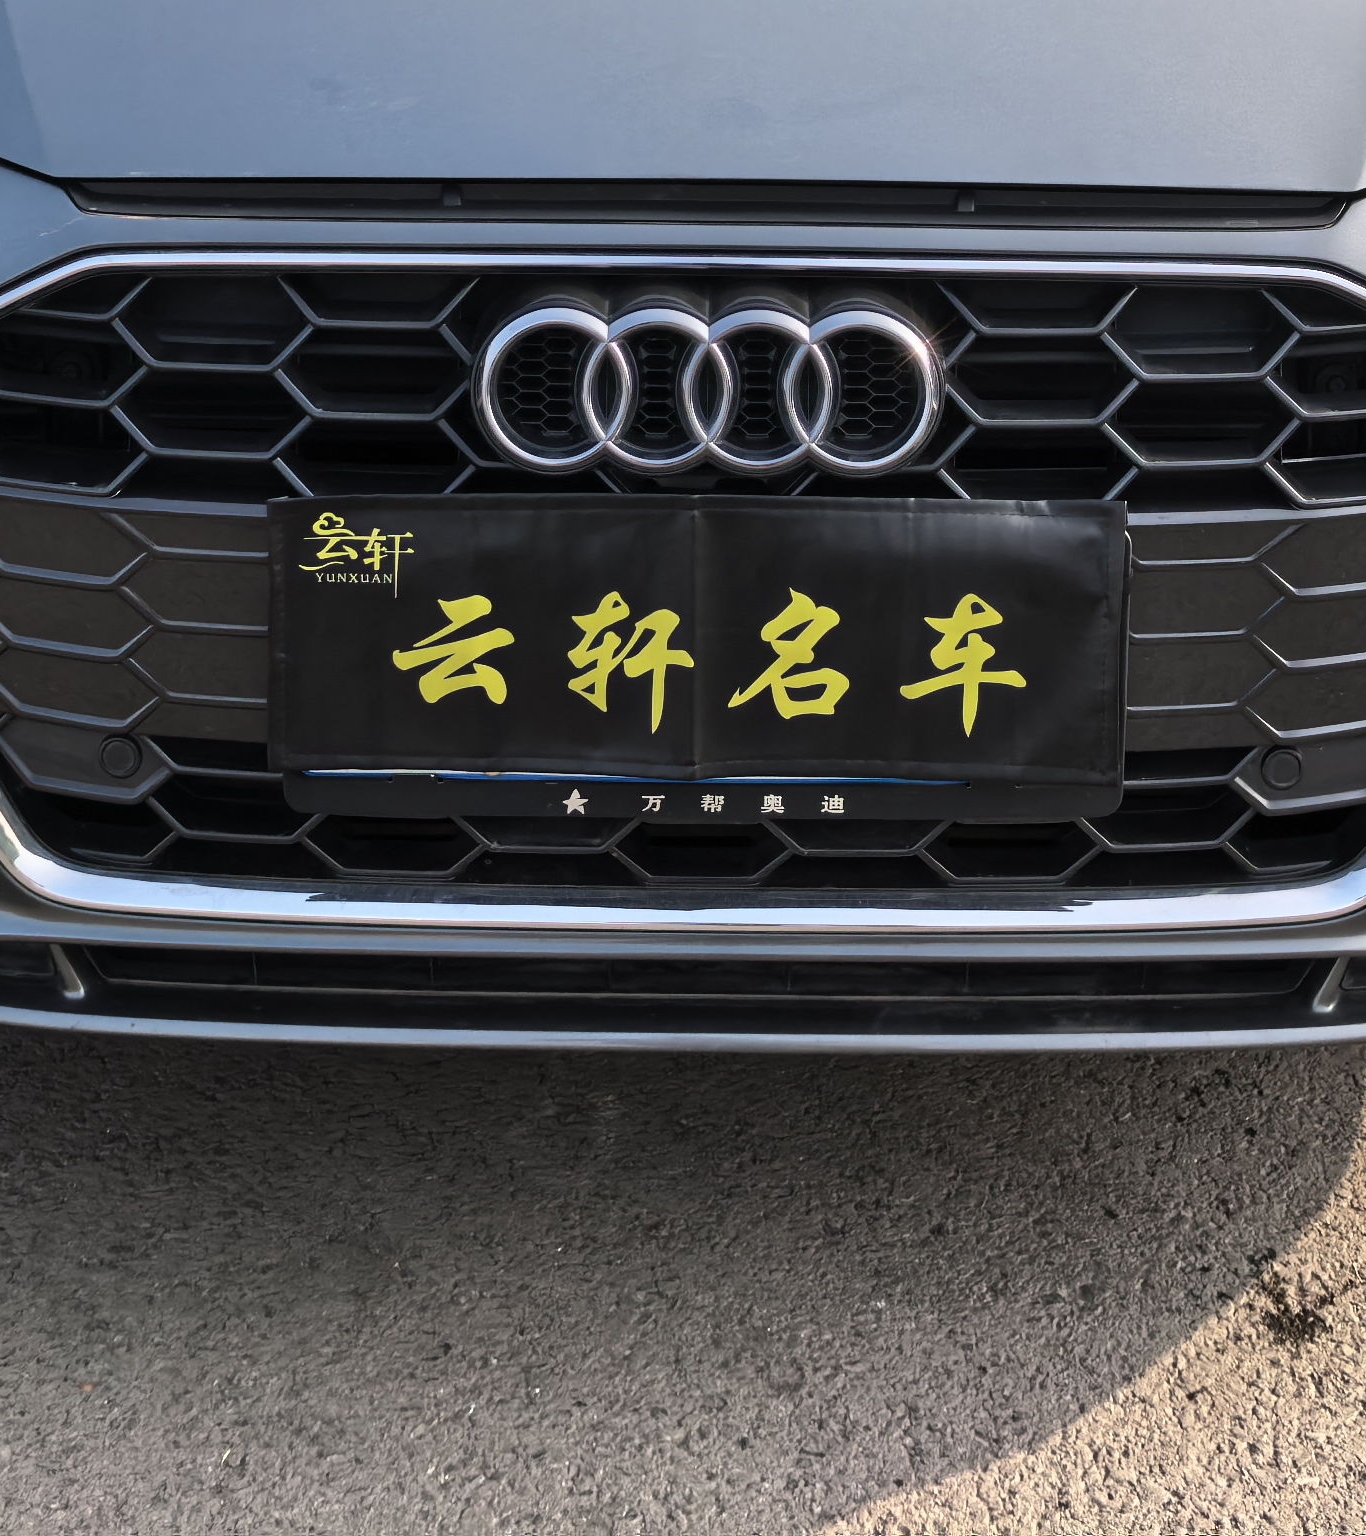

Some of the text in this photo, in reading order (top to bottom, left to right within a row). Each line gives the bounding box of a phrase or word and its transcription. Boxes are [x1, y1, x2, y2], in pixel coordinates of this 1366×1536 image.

[299, 512, 415, 598] 云轩
[315, 572, 393, 584] YUNXUAN
[392, 587, 1027, 738] 云轩名车
[642, 793, 847, 815] 万帮奥迪
